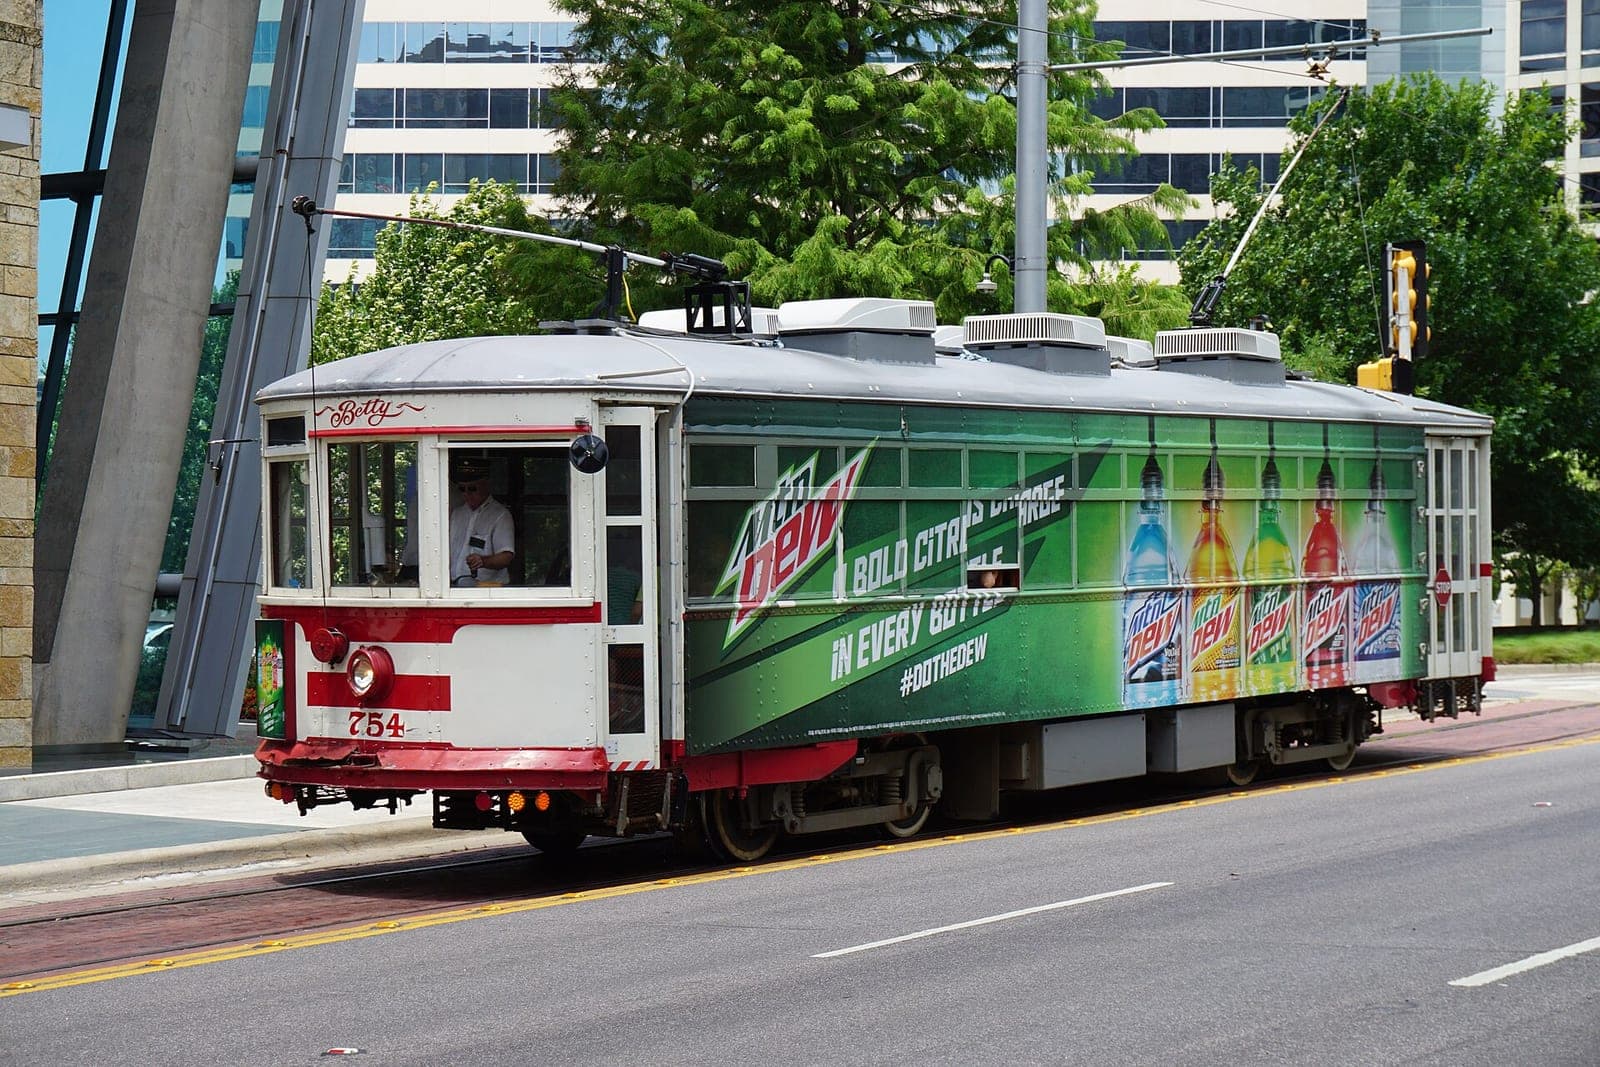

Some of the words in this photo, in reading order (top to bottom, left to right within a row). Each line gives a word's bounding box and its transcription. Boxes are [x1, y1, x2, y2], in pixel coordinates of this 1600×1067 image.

[331, 398, 404, 428] Betty
[853, 538, 908, 597] BOLD
[1436, 581, 1451, 595] STOP
[857, 602, 925, 670] EVERY
[900, 632, 988, 698] #DOTHEDEW
[349, 711, 405, 738] 754
